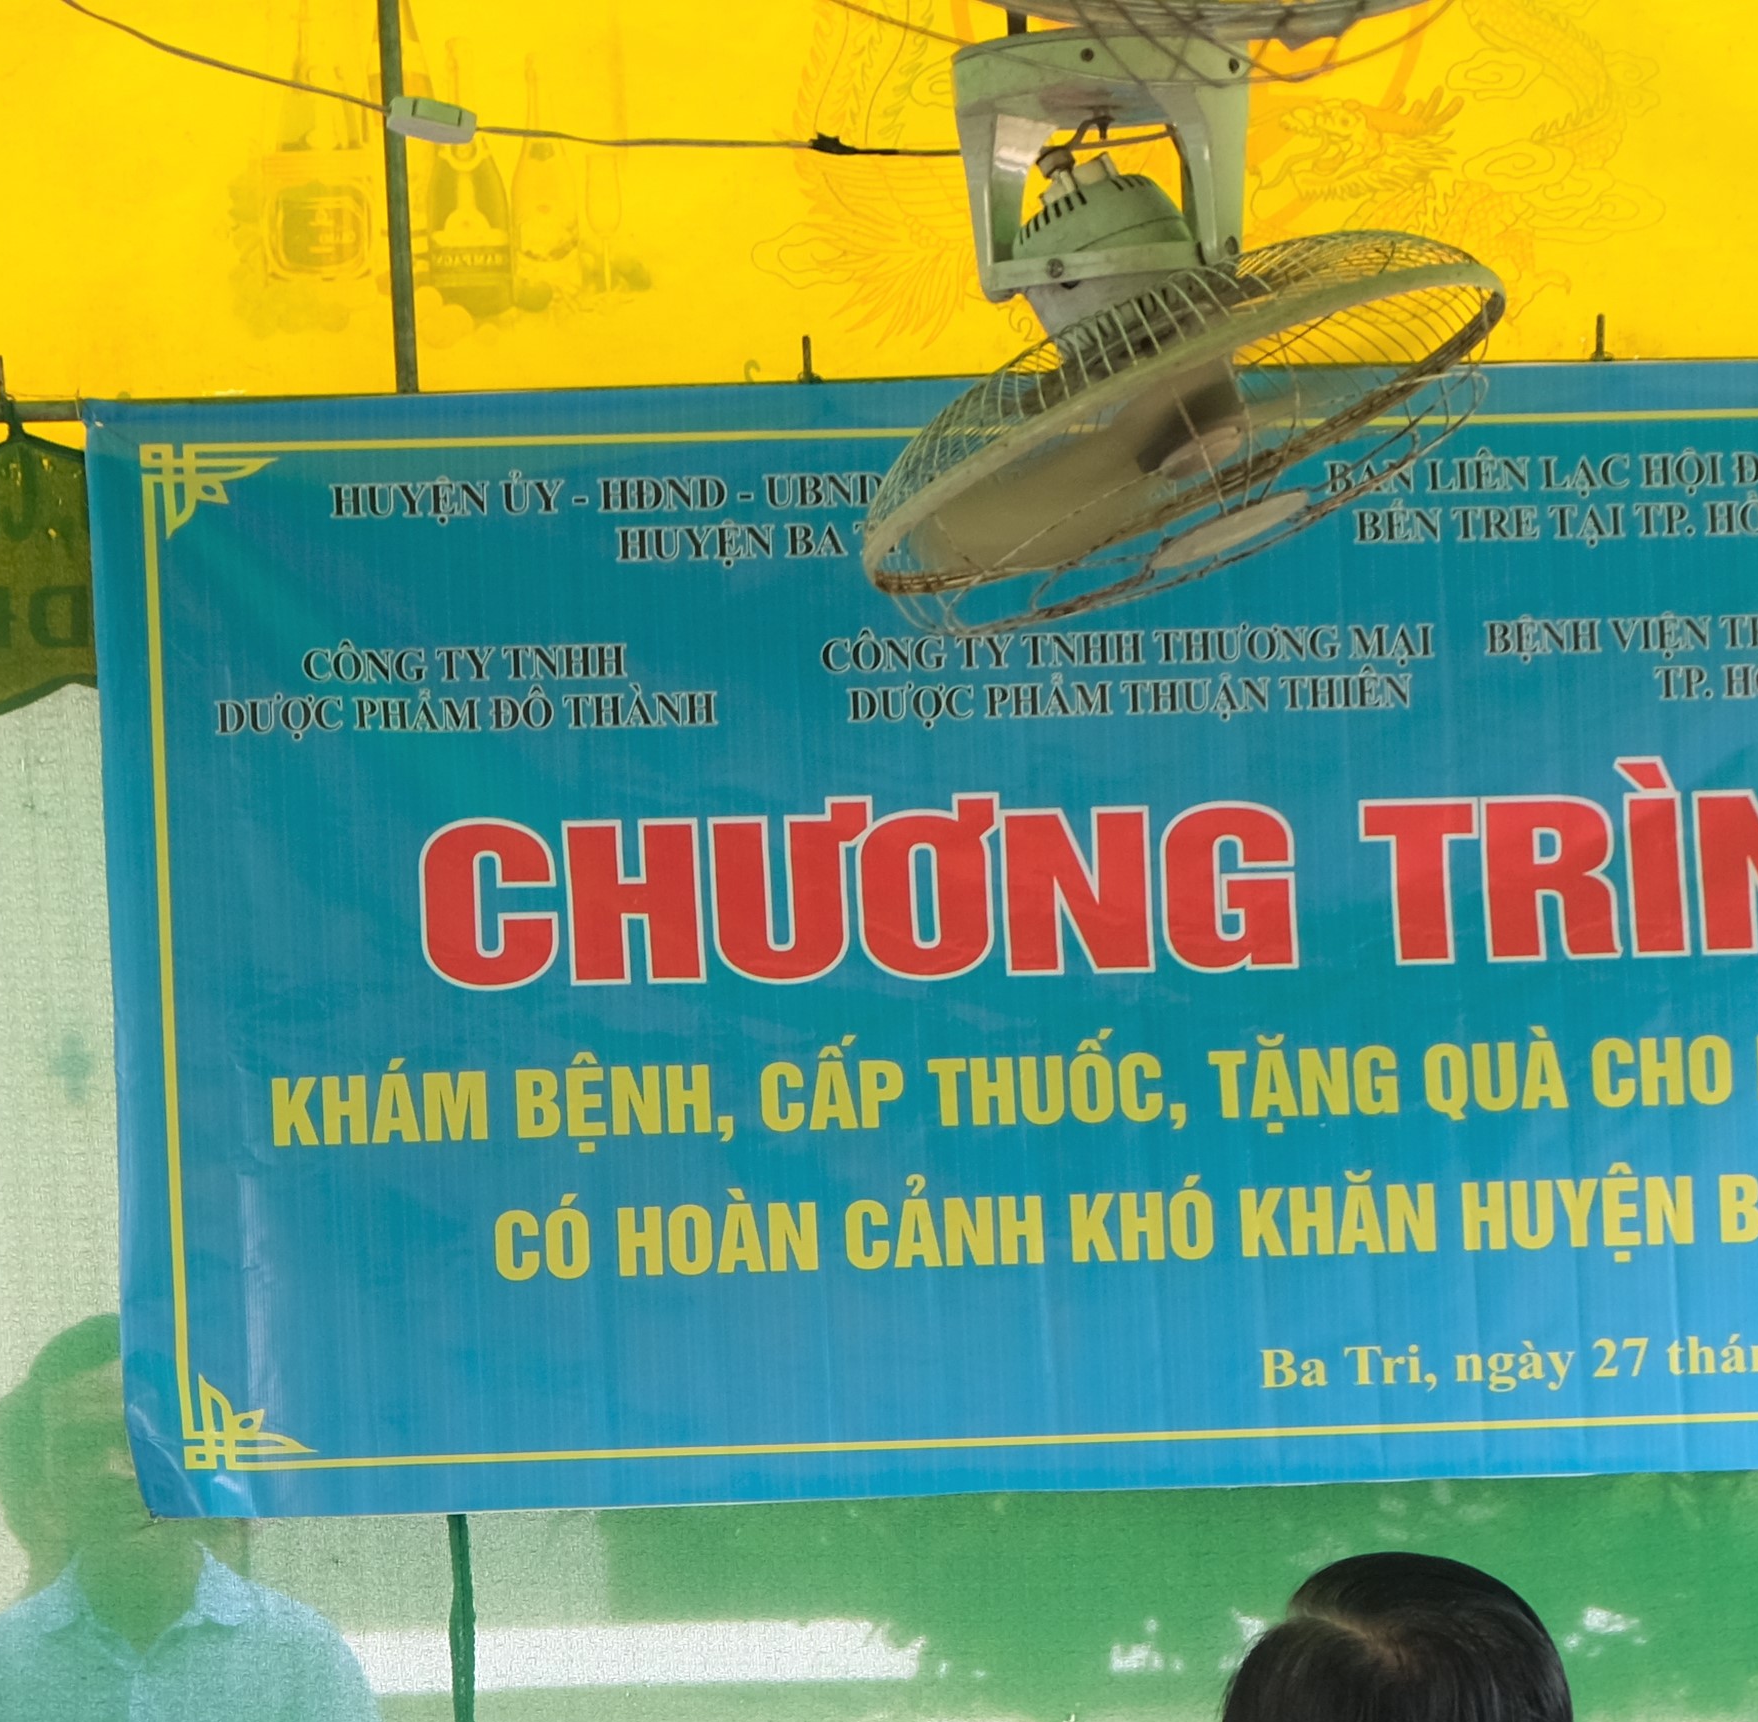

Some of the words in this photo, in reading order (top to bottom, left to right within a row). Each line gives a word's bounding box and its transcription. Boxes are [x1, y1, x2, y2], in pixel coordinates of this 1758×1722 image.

[330, 477, 490, 526] HUYỆN
[503, 469, 564, 517] ỦY
[598, 475, 727, 513] HĐND
[762, 471, 886, 509] UBND
[1424, 446, 1530, 494] LIÊN
[1540, 453, 1631, 499] LẠC
[1642, 447, 1723, 497] HỘI
[617, 518, 774, 568] HUYỆN
[784, 520, 849, 558] BA
[1353, 496, 1442, 545] BẾN
[1451, 505, 1540, 541] TRE
[1547, 503, 1626, 549] TẠI
[1634, 502, 1697, 538] TP.
[301, 640, 426, 684] CÔNG
[434, 645, 495, 683] TY
[503, 642, 627, 680] TNHH
[822, 629, 947, 674] CÔNG
[955, 635, 1014, 672] TY
[1022, 632, 1146, 670] TNHH
[1153, 625, 1341, 667] THƯƠNG
[1349, 623, 1436, 668] MẠI
[1484, 612, 1601, 664] BỆNH
[1611, 608, 1711, 660] VIỆN
[847, 685, 974, 730] DƯỢC
[984, 674, 1113, 720] PHẨM
[1121, 673, 1272, 721] THUẬN
[1279, 667, 1411, 712] THIÊN
[1654, 664, 1715, 703] TP.
[215, 696, 345, 742] DƯỢC
[354, 686, 481, 734] PHẨM
[491, 686, 552, 731] ĐÔ
[562, 687, 718, 730] THÀNH
[420, 791, 1299, 988] CHƯƠNG
[271, 1057, 489, 1148] KHÁM
[515, 1050, 735, 1157] BỆNH,
[760, 1032, 905, 1133] CẤP
[927, 1026, 1189, 1133] THUỐC,
[1208, 1032, 1400, 1135] TẶNG
[1424, 1026, 1571, 1122] QUÀ
[1592, 1035, 1734, 1110] CHO
[494, 1192, 593, 1282] CÓ
[617, 1185, 820, 1278] HOÀN
[845, 1175, 1046, 1272] CẢNH
[1070, 1172, 1215, 1264] KHÓ
[1240, 1168, 1438, 1259] KHĂN
[1462, 1162, 1695, 1266] HUYỆN
[1261, 1349, 1328, 1389] Ba
[1344, 1345, 1437, 1393] Tri,
[1454, 1341, 1574, 1391] ngày
[1593, 1337, 1648, 1378] 27
